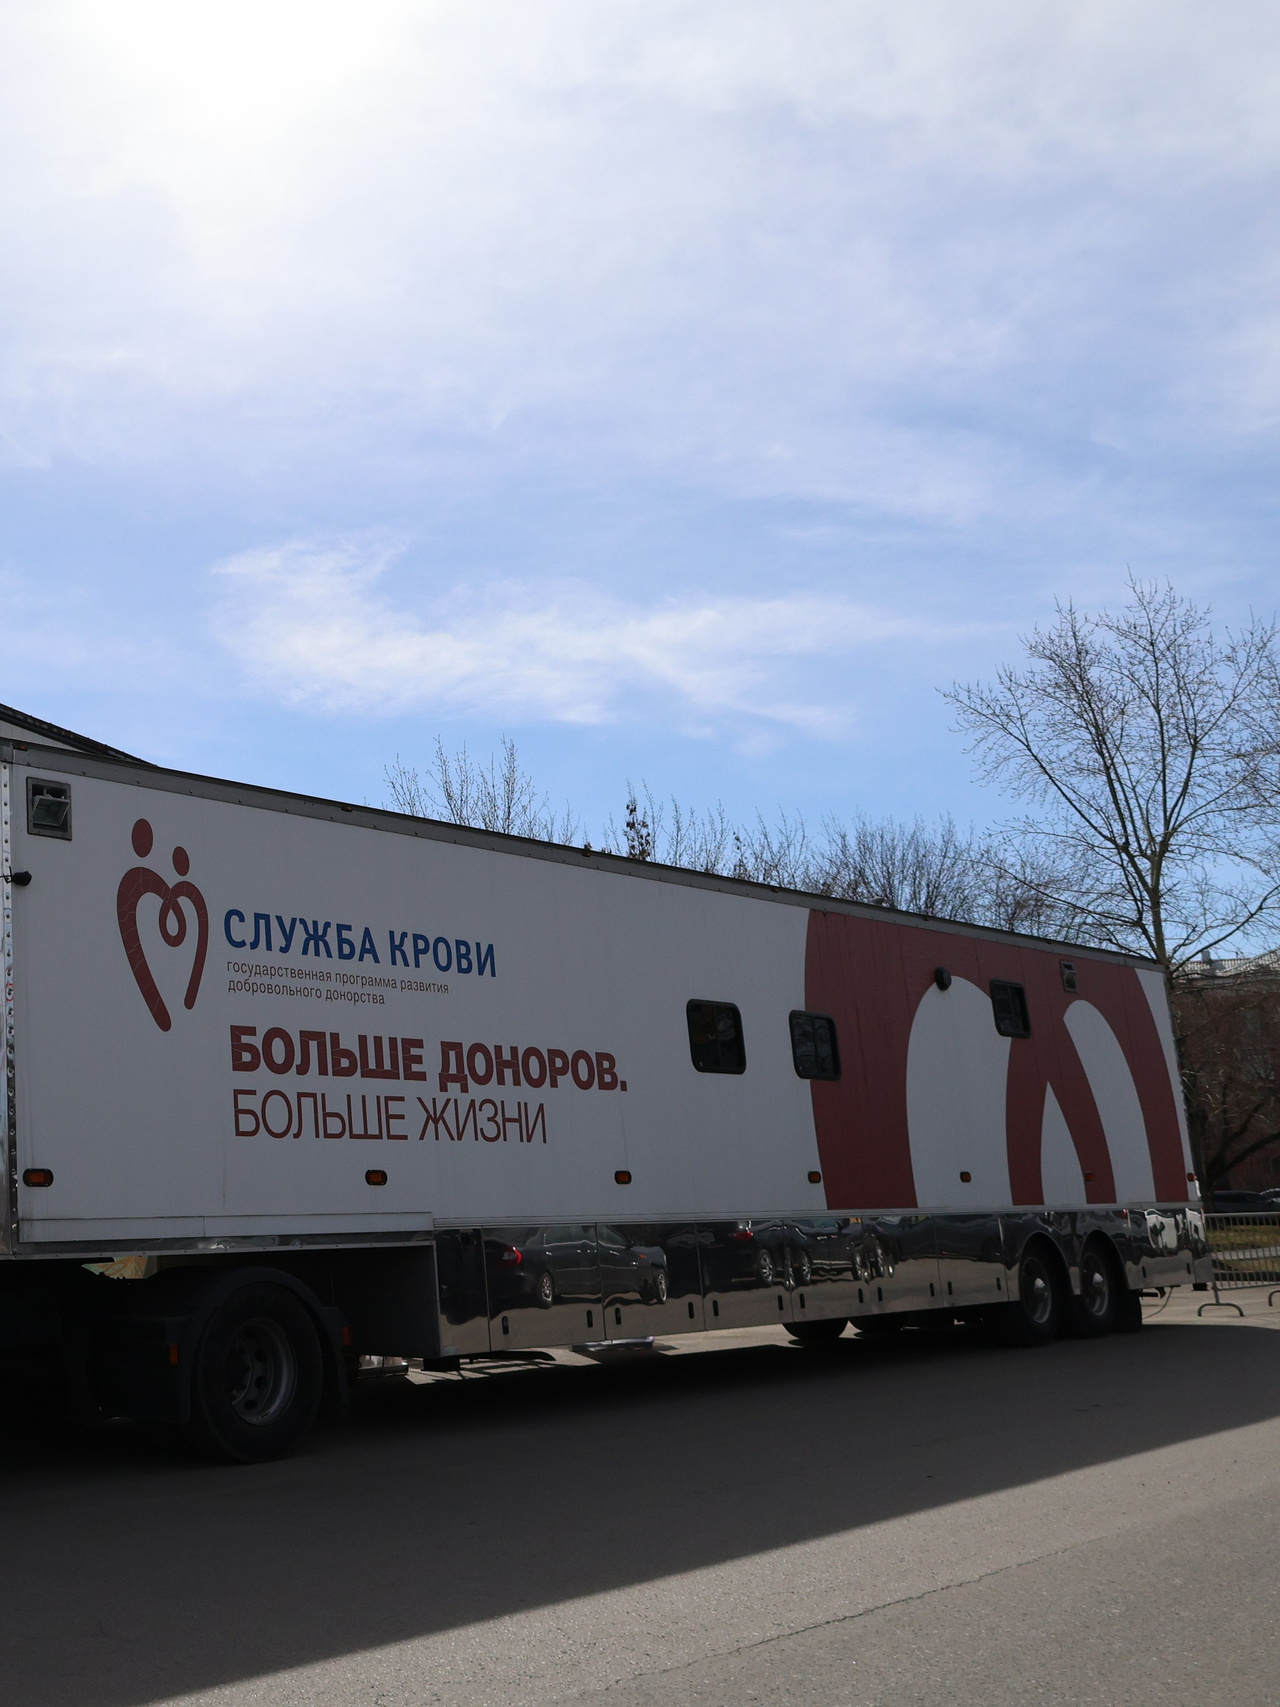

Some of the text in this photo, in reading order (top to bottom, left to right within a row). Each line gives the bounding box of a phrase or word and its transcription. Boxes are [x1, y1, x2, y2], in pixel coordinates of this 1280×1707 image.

[224, 908, 497, 978] СЛУЖБА КРОВИ
[227, 961, 450, 994] государственная программа развития
[228, 979, 386, 1005] добровольного донорства
[230, 1025, 628, 1093] БОЛЬШЕ ДОНОРОВ.
[233, 1089, 547, 1144] БОЛЬШЕ ЖИЗНИ
